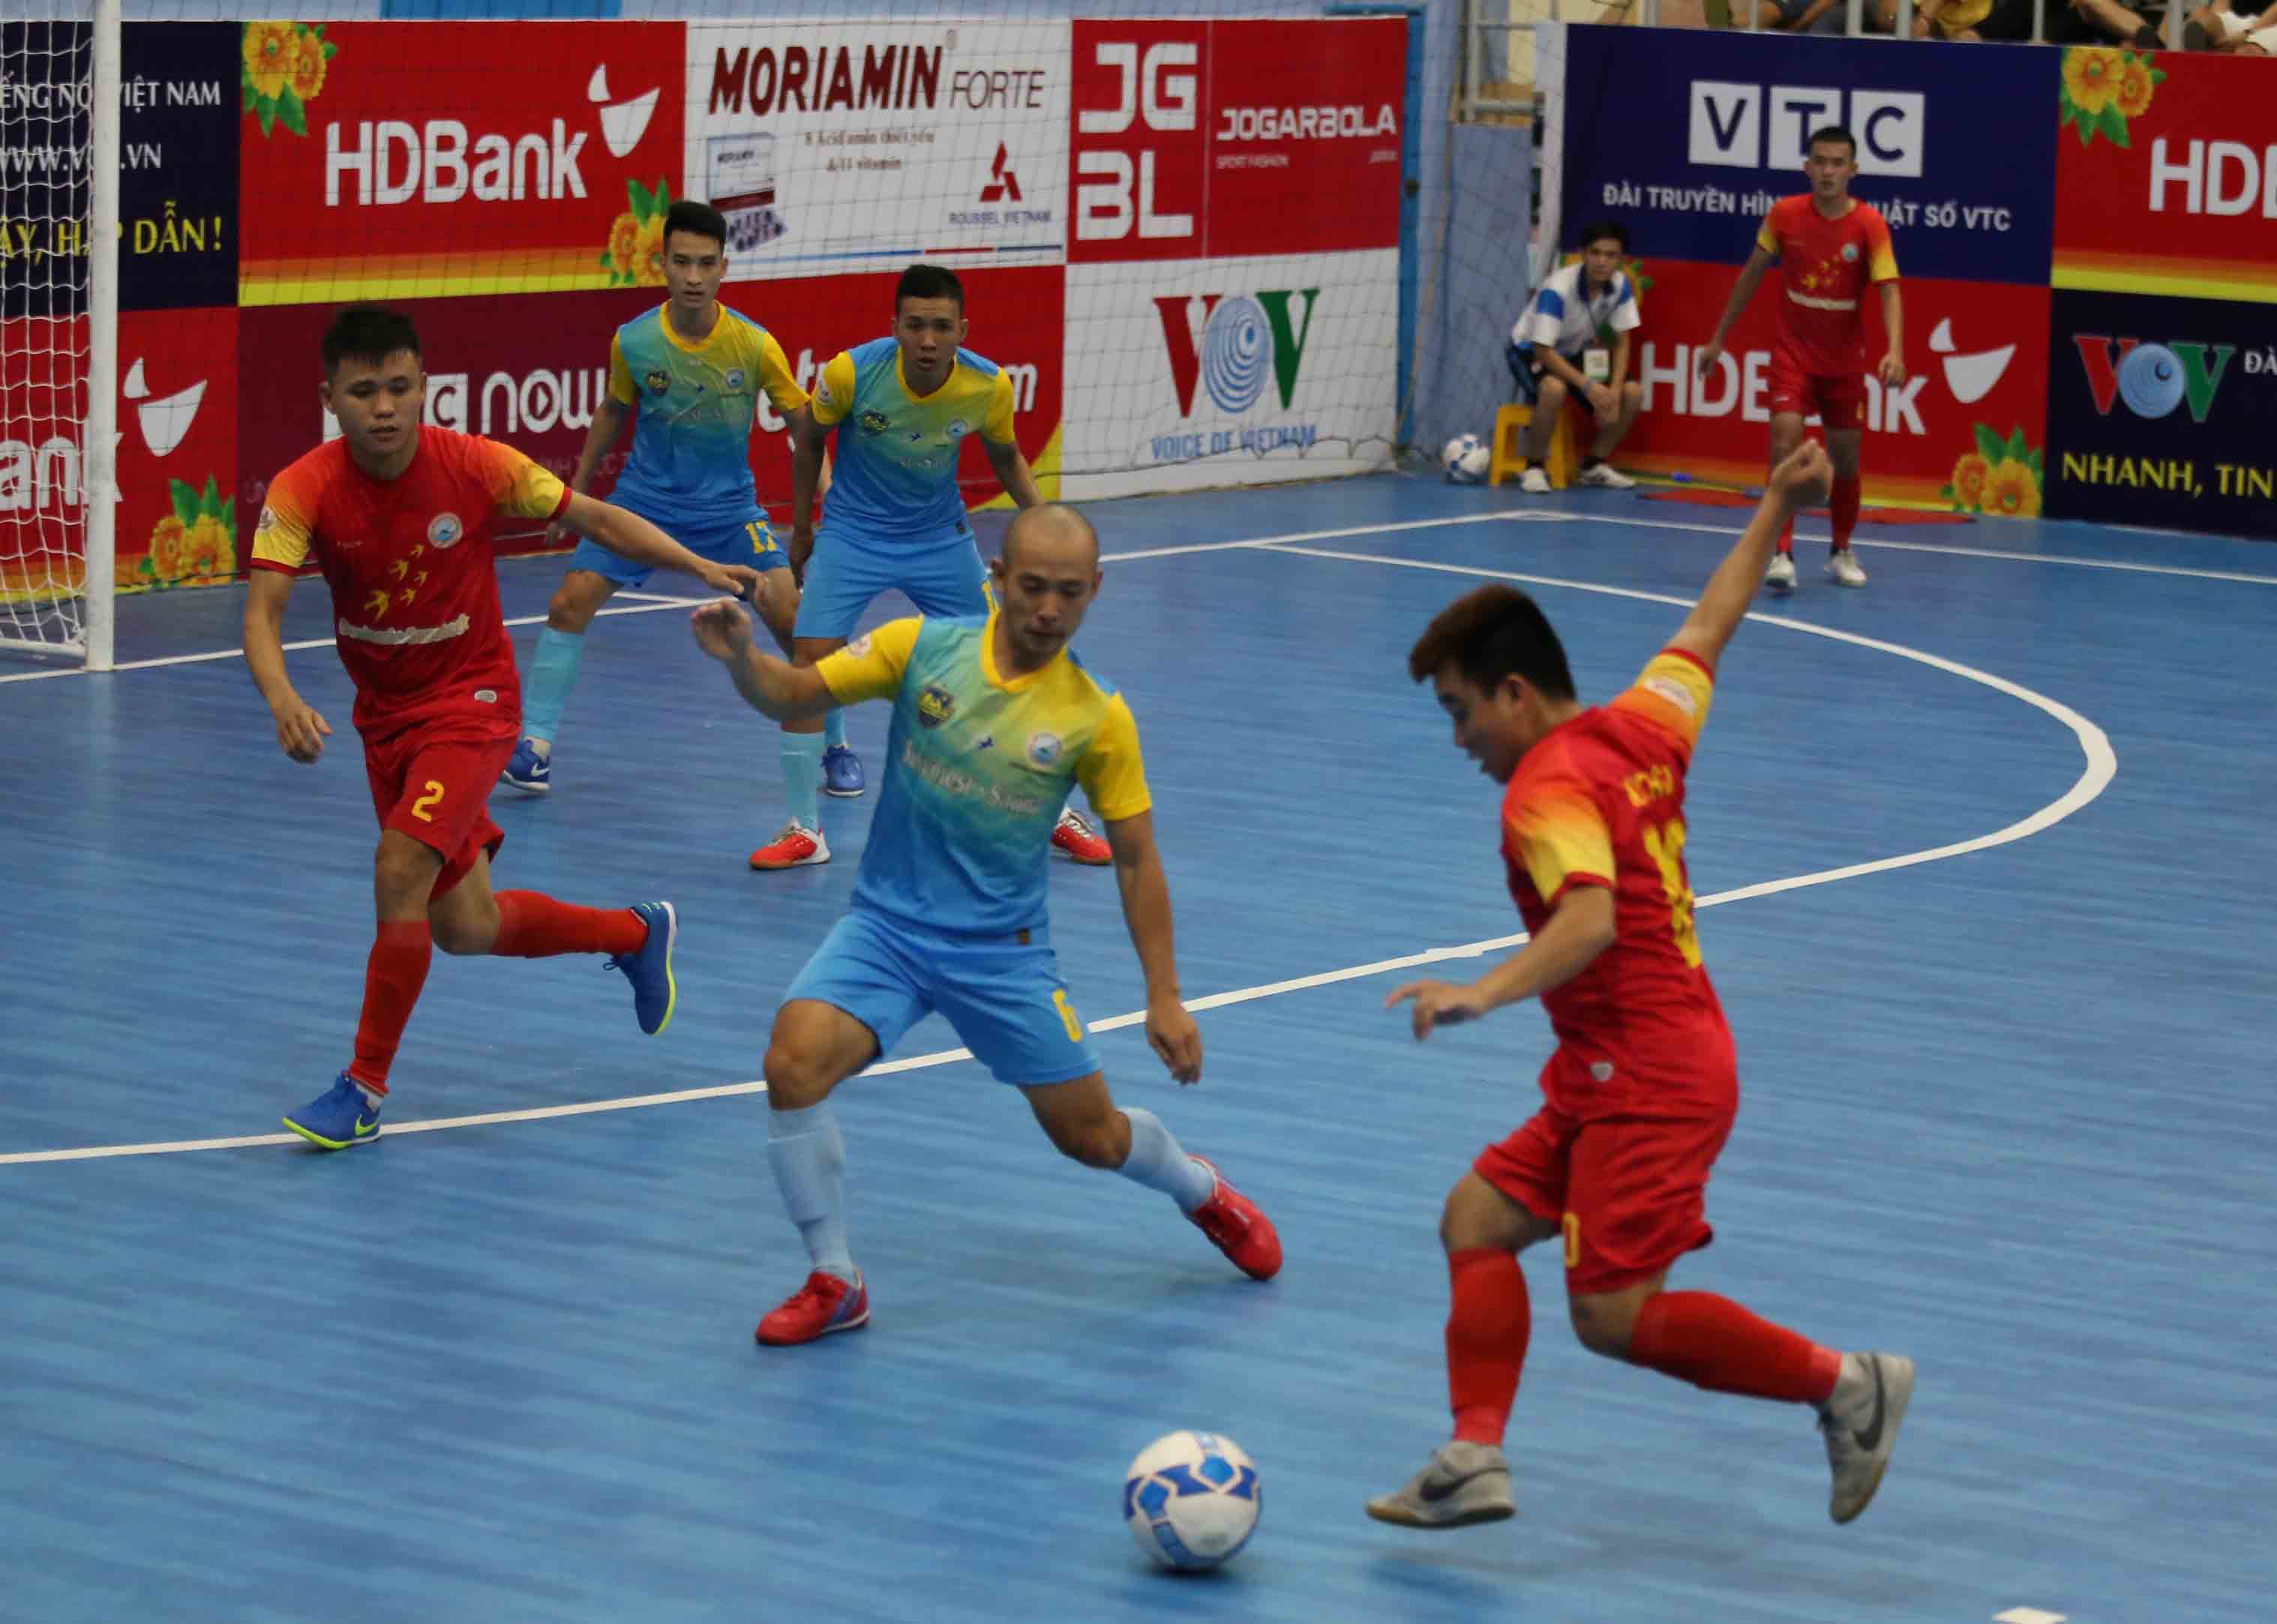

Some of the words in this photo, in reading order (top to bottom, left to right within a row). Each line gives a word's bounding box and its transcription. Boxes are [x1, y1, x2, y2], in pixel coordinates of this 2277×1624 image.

[119, 75, 160, 113] IỆT
[166, 80, 221, 106] NAM
[708, 45, 943, 116] MORIAMIN
[949, 70, 1046, 109] FORTE
[1078, 42, 1198, 133] JG
[1216, 104, 1397, 142] JOGARBOLA
[326, 118, 587, 206] HDBank
[1076, 150, 1194, 241] BL
[1603, 181, 1641, 206] ĐÀI
[1648, 184, 1735, 213] TRUYỀN
[1963, 207, 2011, 232] VTC
[2062, 452, 2203, 498] NHANH,
[2215, 463, 2272, 498] TIN
[746, 520, 777, 553] 17
[411, 781, 444, 822] 2
